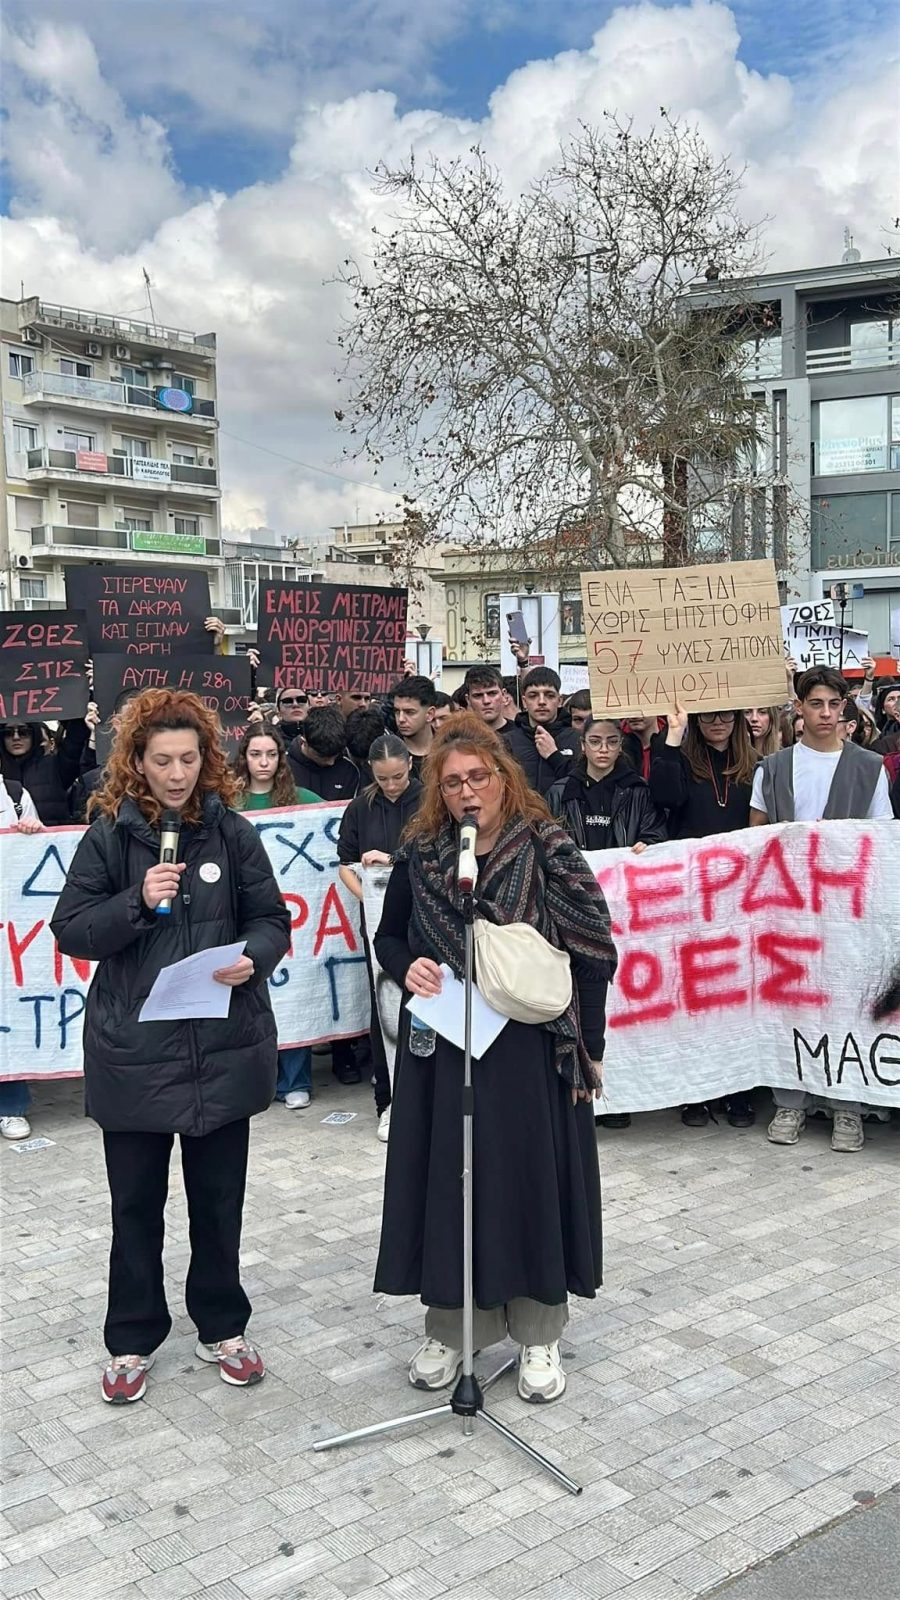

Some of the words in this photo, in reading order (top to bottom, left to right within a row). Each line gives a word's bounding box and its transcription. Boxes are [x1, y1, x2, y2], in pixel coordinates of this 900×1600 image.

[103, 576, 188, 594] ΣΤΕΡΕΨΑΝ
[587, 580, 635, 607] ΕΝΑ
[652, 575, 737, 603] ΤΑΞΙΔΙ
[98, 600, 119, 616] ΤΑ
[128, 600, 182, 616] ΔΑΚΡΥΑ
[266, 589, 322, 615] ΕΜΕΙΣ
[332, 592, 408, 620] ΜΕΤΡΑΜΕ
[789, 602, 835, 624] ΖΩΕΣ
[101, 623, 129, 639] ΚΑΙ
[136, 622, 190, 639] ΕΓΙΝΑΝ
[268, 617, 371, 643] ΑΝΘΡΩΠΙΝΕΣ
[588, 608, 652, 636] ΧΩΡΙΣ
[2, 624, 84, 649] ΖΩΕΣ
[808, 637, 842, 652] ΣΤΟ
[282, 643, 331, 668] ΕΣΕΙΣ
[334, 646, 406, 674] ΜΕΤΡΑΤΕ
[593, 639, 644, 675] 57
[656, 639, 714, 665] ΨΥΧΕΣ
[720, 635, 780, 661] ΖΗΤΟΥΝ
[15, 660, 81, 682] ΣΤΙΣ
[122, 668, 169, 687] ΑΥΤΗ
[179, 670, 193, 687] Η
[202, 671, 232, 692] 28η
[274, 666, 324, 691] ΚΕΡΔΗ
[327, 670, 349, 692] ΚΑΙ
[605, 672, 731, 708] ΔΙΚΑΙΩΣΗ
[224, 696, 251, 712] ΟΧΙ
[608, 932, 829, 1029] ΩΕΣ
